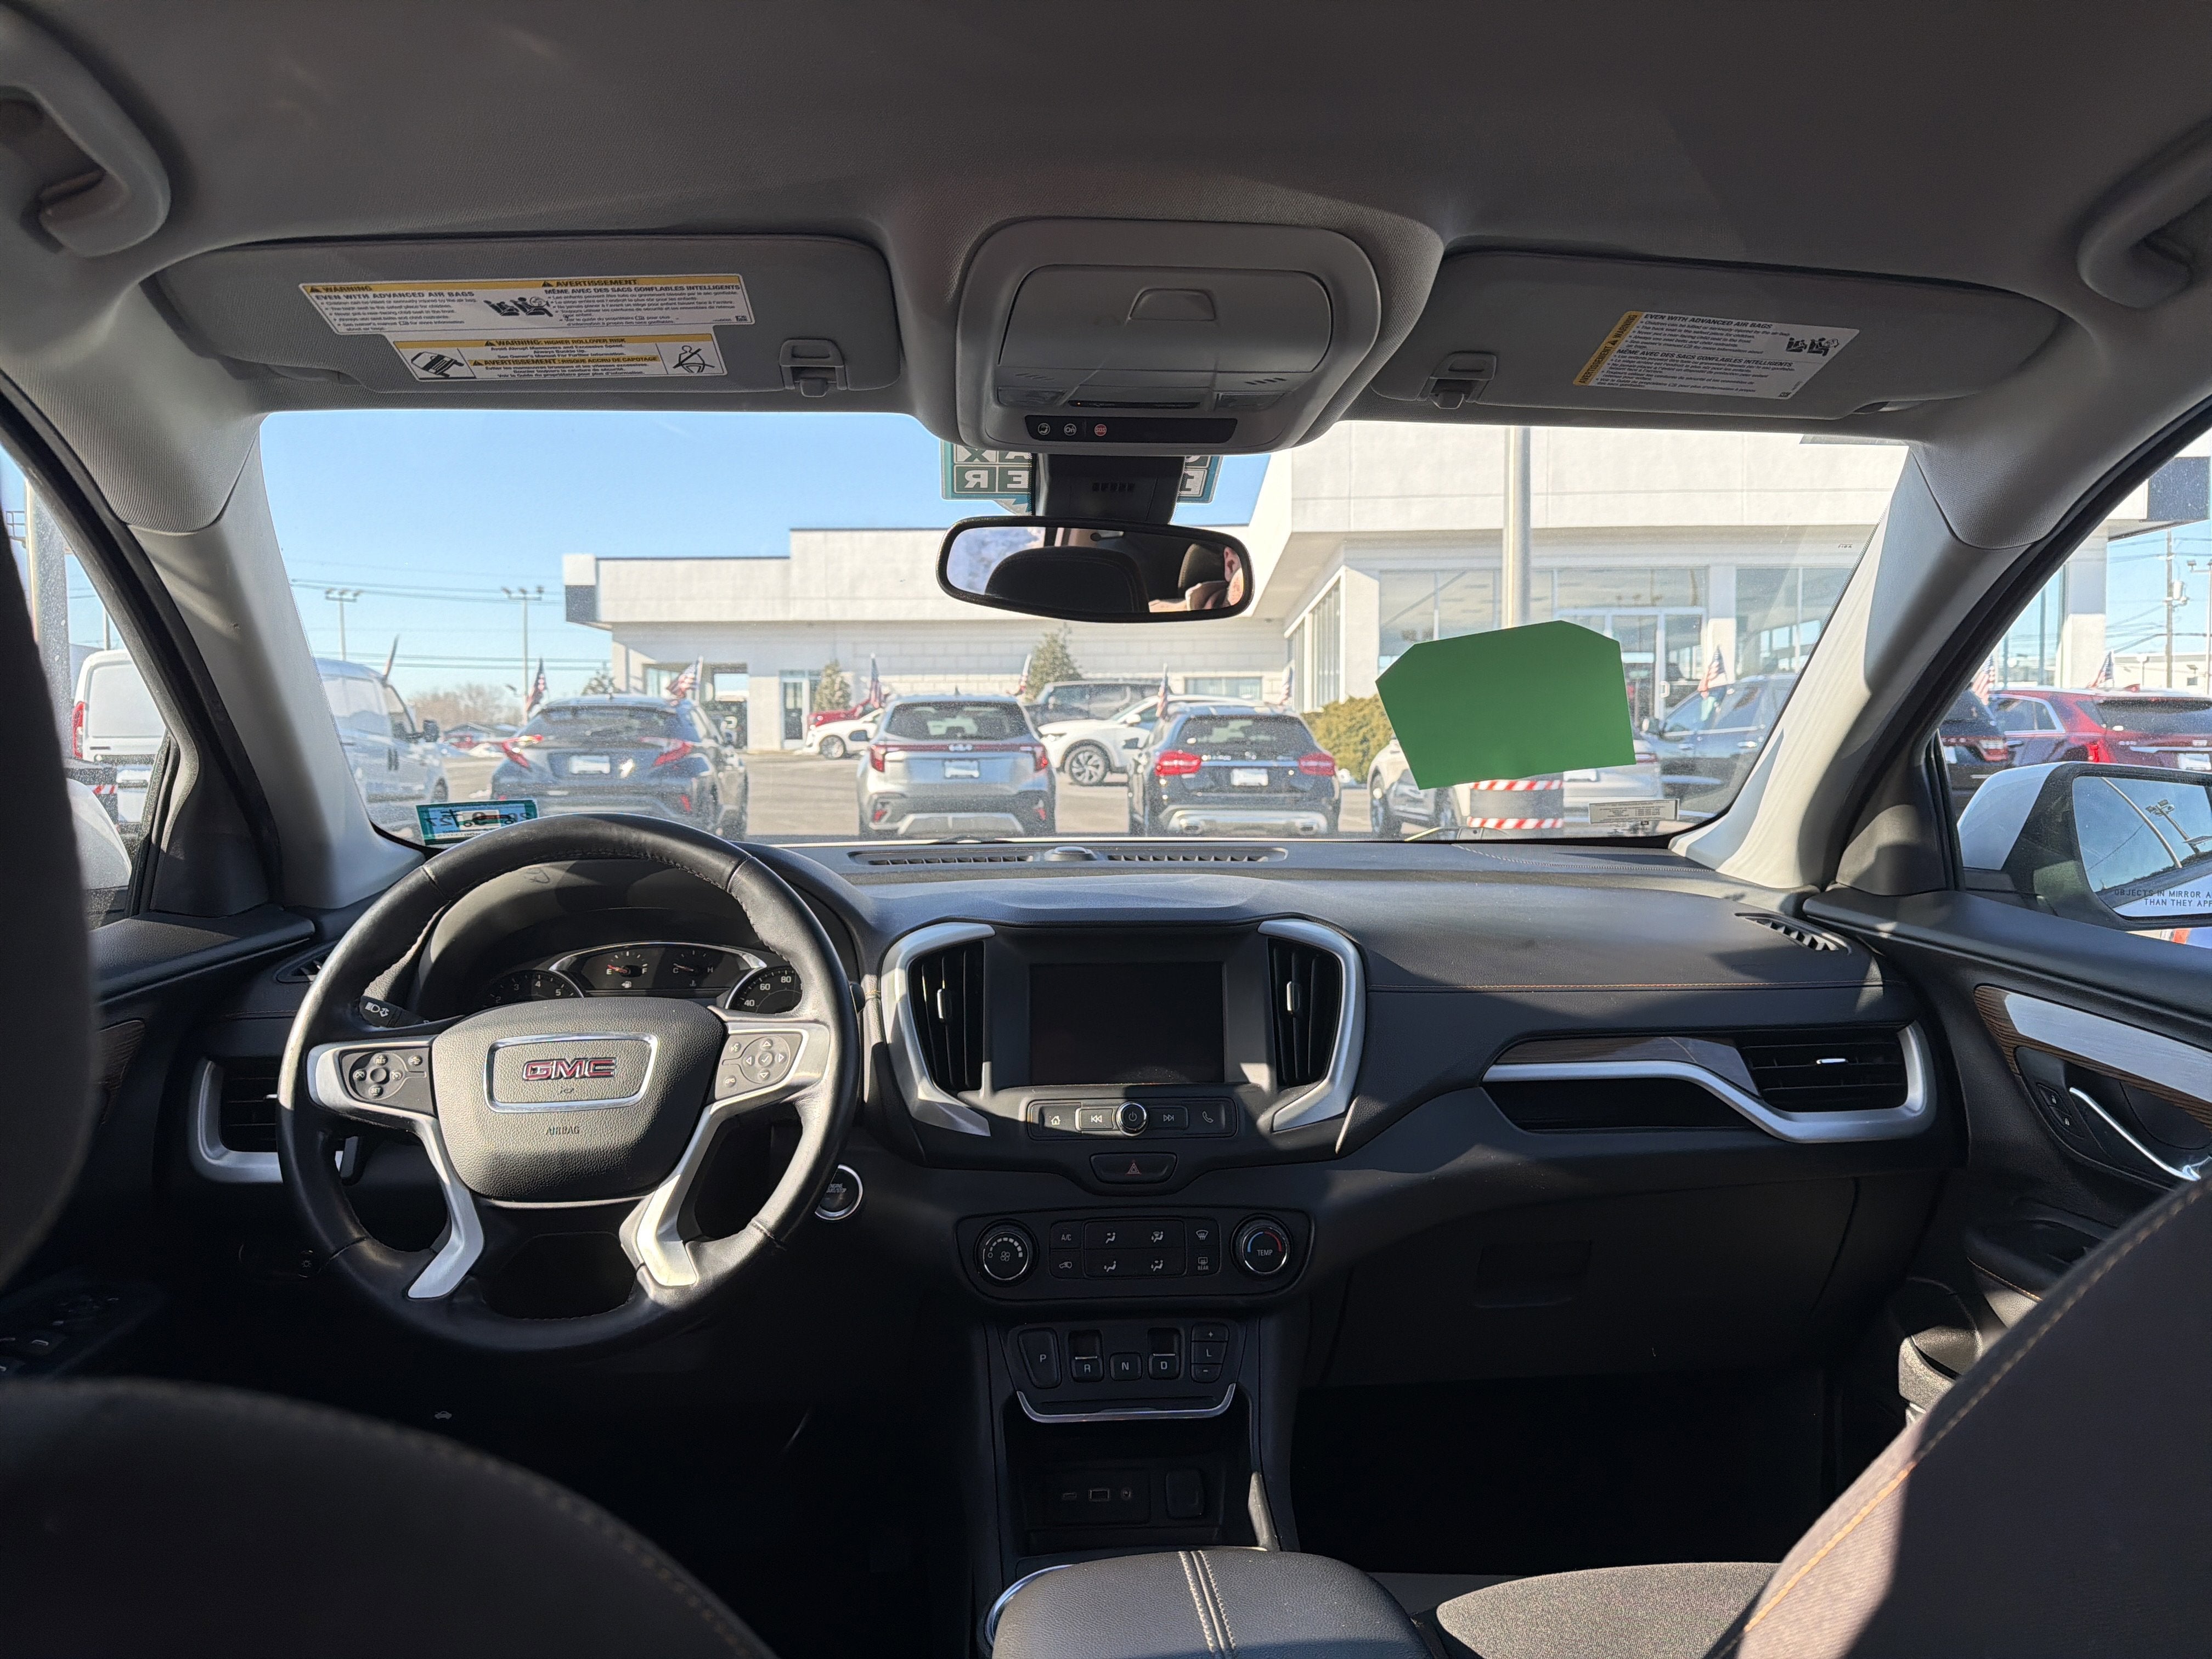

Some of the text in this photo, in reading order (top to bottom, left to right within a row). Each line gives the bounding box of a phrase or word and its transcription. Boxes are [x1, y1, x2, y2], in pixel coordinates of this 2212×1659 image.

[1697, 355, 1743, 363] GONFLABLES
[522, 1057, 617, 1081] GMC
[546, 1126, 580, 1135] AIRBAG
[1206, 1349, 1212, 1357] L
[1040, 1354, 1047, 1363] P
[1084, 1364, 1091, 1373] R
[1121, 1362, 1129, 1370] N
[1160, 1362, 1168, 1370] D
